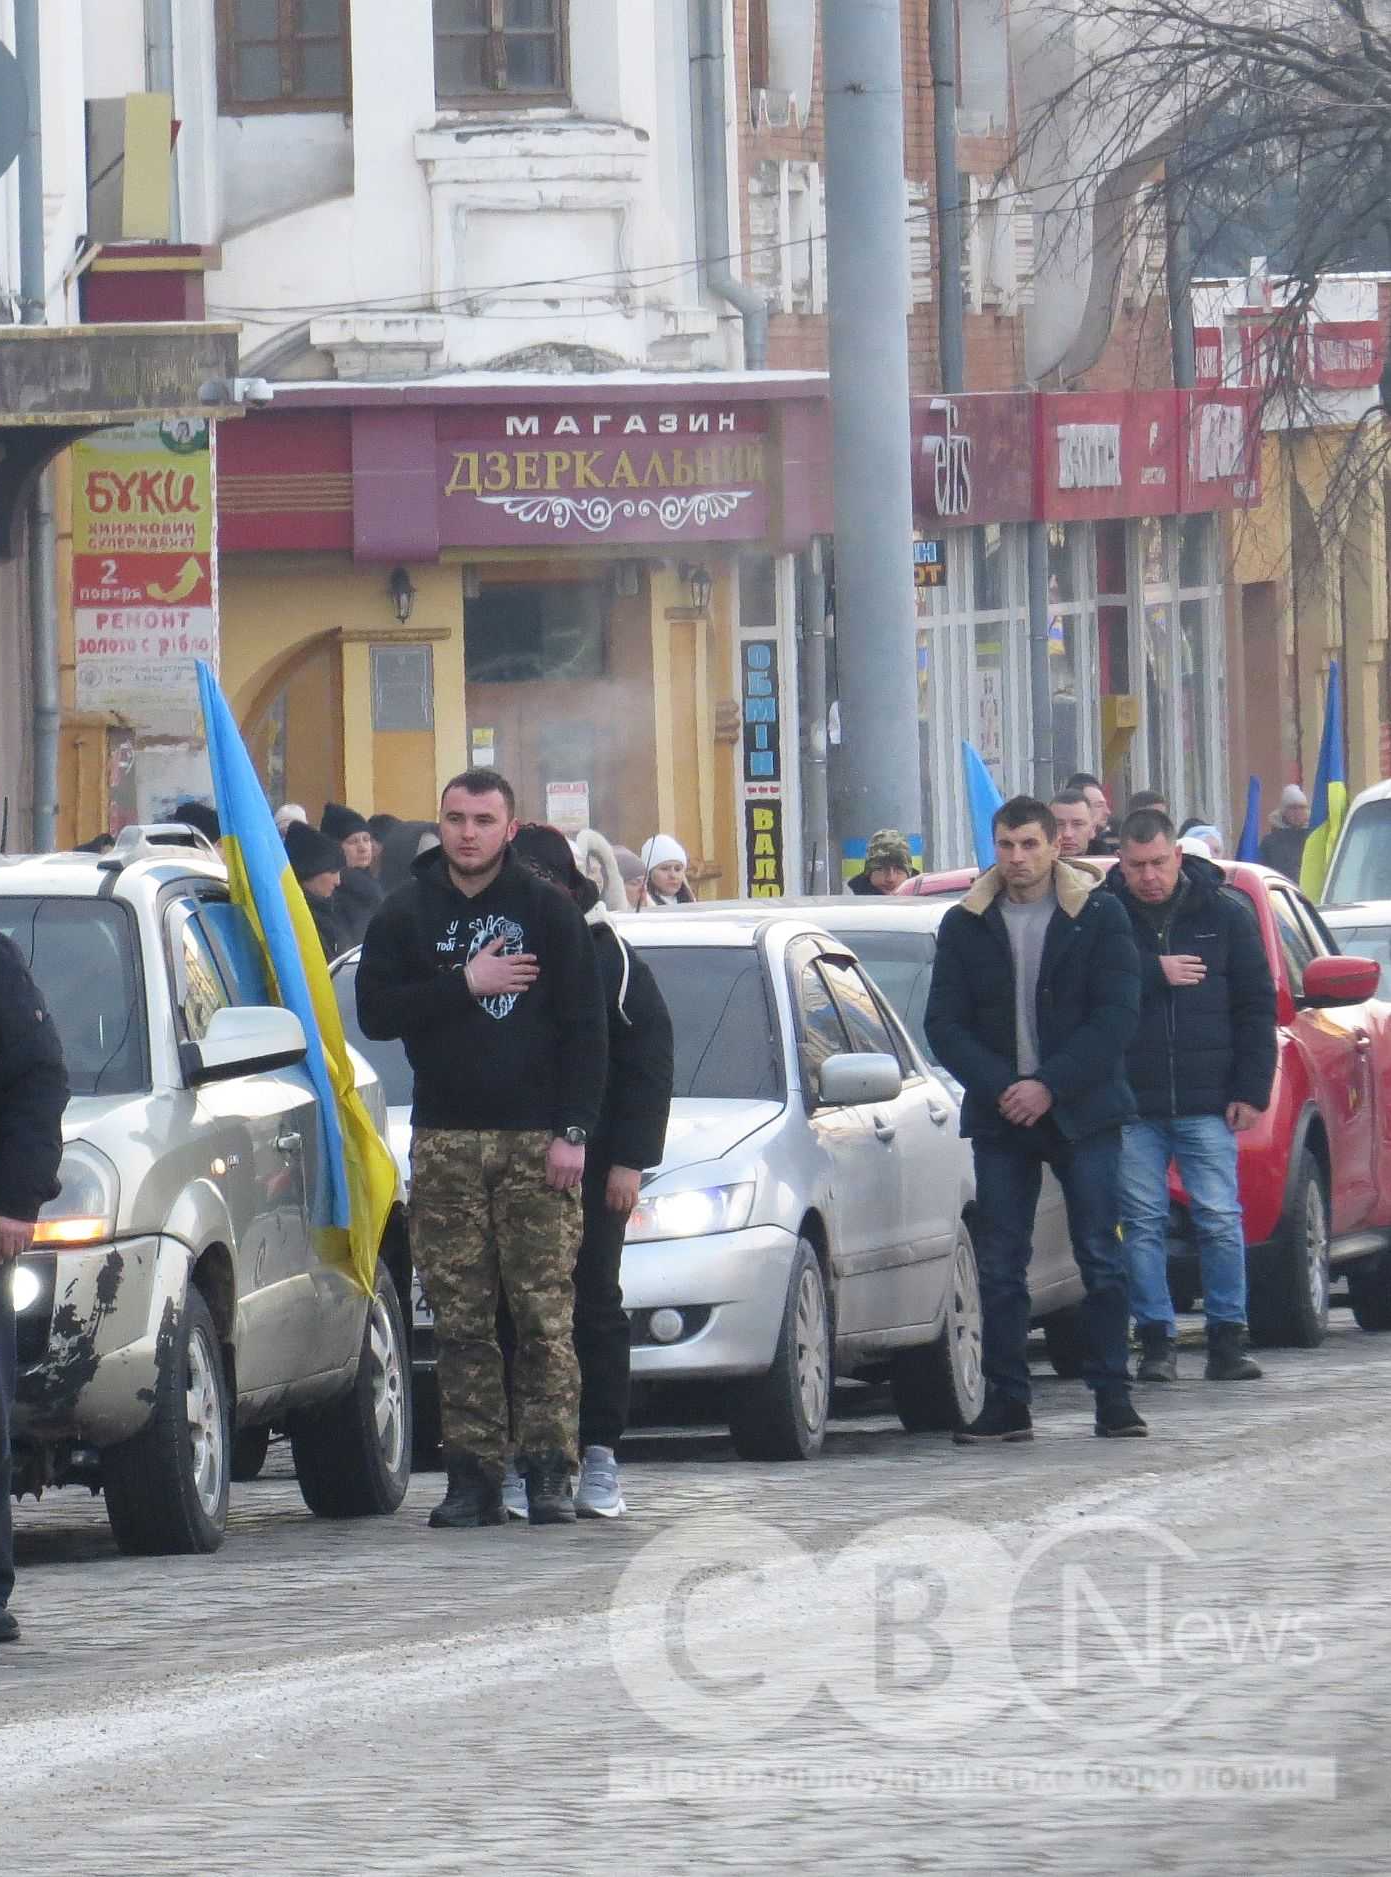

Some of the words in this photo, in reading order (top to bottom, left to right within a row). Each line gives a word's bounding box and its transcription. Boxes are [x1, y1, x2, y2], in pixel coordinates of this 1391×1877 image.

[506, 413, 735, 436] МАГАЗИН
[85, 469, 200, 514] БУКИ
[100, 559, 118, 584] 2
[96, 611, 190, 631] РЕМОНТ
